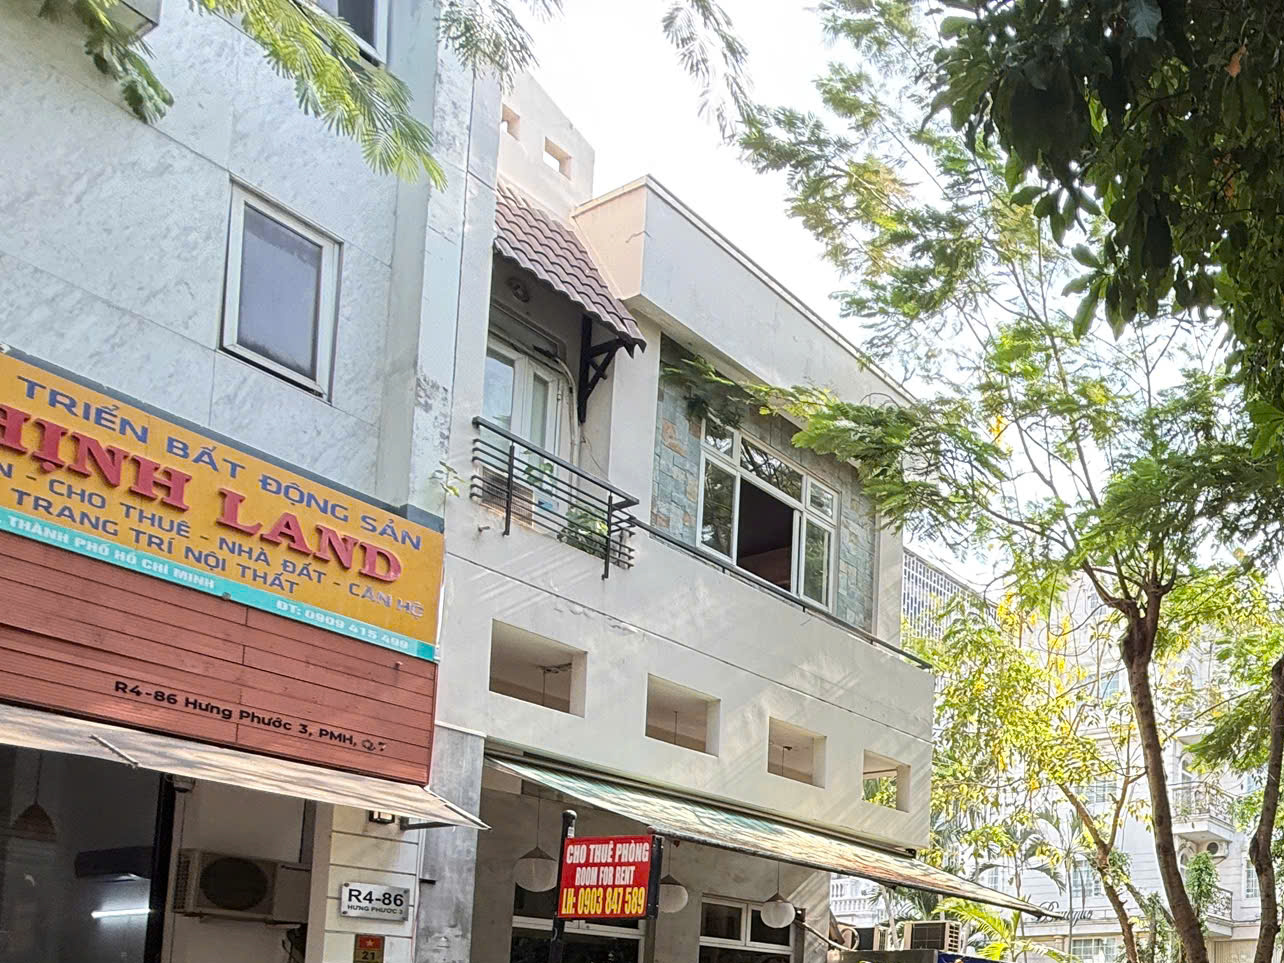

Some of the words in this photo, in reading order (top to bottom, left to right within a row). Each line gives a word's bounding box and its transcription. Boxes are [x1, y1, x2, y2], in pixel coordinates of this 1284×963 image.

[17, 376, 149, 444] TRIỂN
[166, 436, 246, 479] BẤT
[258, 474, 349, 523] ĐỘNG
[360, 513, 422, 551] SẢN
[8, 514, 69, 544] THÀNH
[74, 535, 110, 557] PHỐ
[173, 568, 215, 589] MINH
[10, 487, 119, 537] TRANG
[129, 527, 173, 555] TRÍ
[184, 545, 227, 572] NỘI
[236, 562, 300, 594] THẤT
[48, 478, 107, 510] CHO
[119, 501, 191, 539] THUÊ
[218, 536, 271, 567] NHÀ
[280, 558, 327, 584] ĐẤT
[215, 487, 403, 583] LAND
[304, 609, 345, 629] 0909
[348, 620, 379, 640] 415
[114, 679, 178, 705] R4-86
[184, 696, 234, 720] Hưng
[239, 708, 292, 732] Phước
[298, 723, 313, 738] 3,
[319, 728, 358, 747] PMH,
[566, 844, 587, 864] CHO
[589, 840, 614, 863] THUÊ
[614, 839, 650, 863] PHÒNG
[575, 866, 598, 886] ROOM
[598, 866, 614, 886] FOR
[614, 865, 636, 885] RENT
[347, 888, 404, 907] R4-86
[561, 887, 576, 915] LH:
[577, 887, 604, 915] 0903
[605, 887, 624, 915] 847
[624, 886, 646, 915] 589
[361, 950, 375, 961] 21
